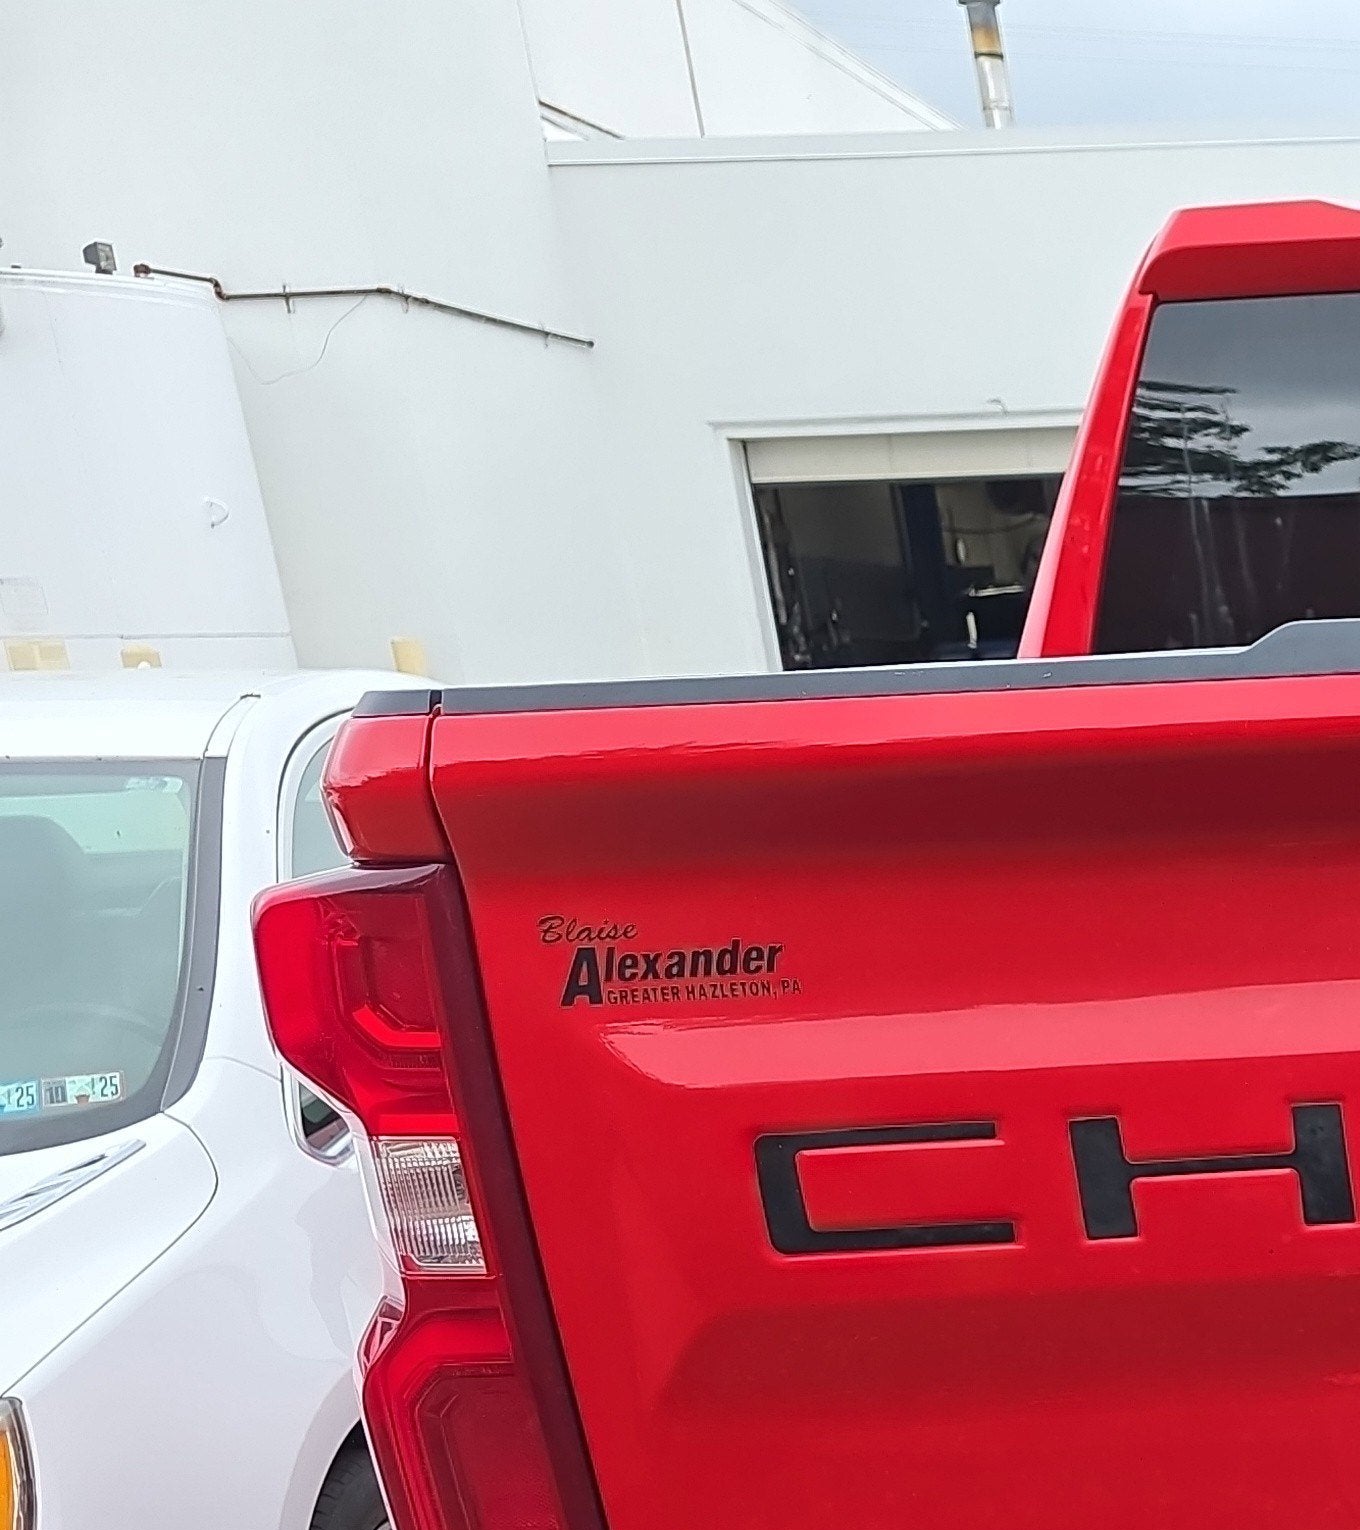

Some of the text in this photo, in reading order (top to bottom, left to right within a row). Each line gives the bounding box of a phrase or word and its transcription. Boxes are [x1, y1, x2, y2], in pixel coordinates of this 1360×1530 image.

[538, 914, 639, 944] Blaise
[560, 938, 784, 1008] Alexander
[606, 978, 802, 1005] GREATER HAZLETON, PA
[15, 1084, 35, 1108] 25
[99, 1075, 119, 1097] 25
